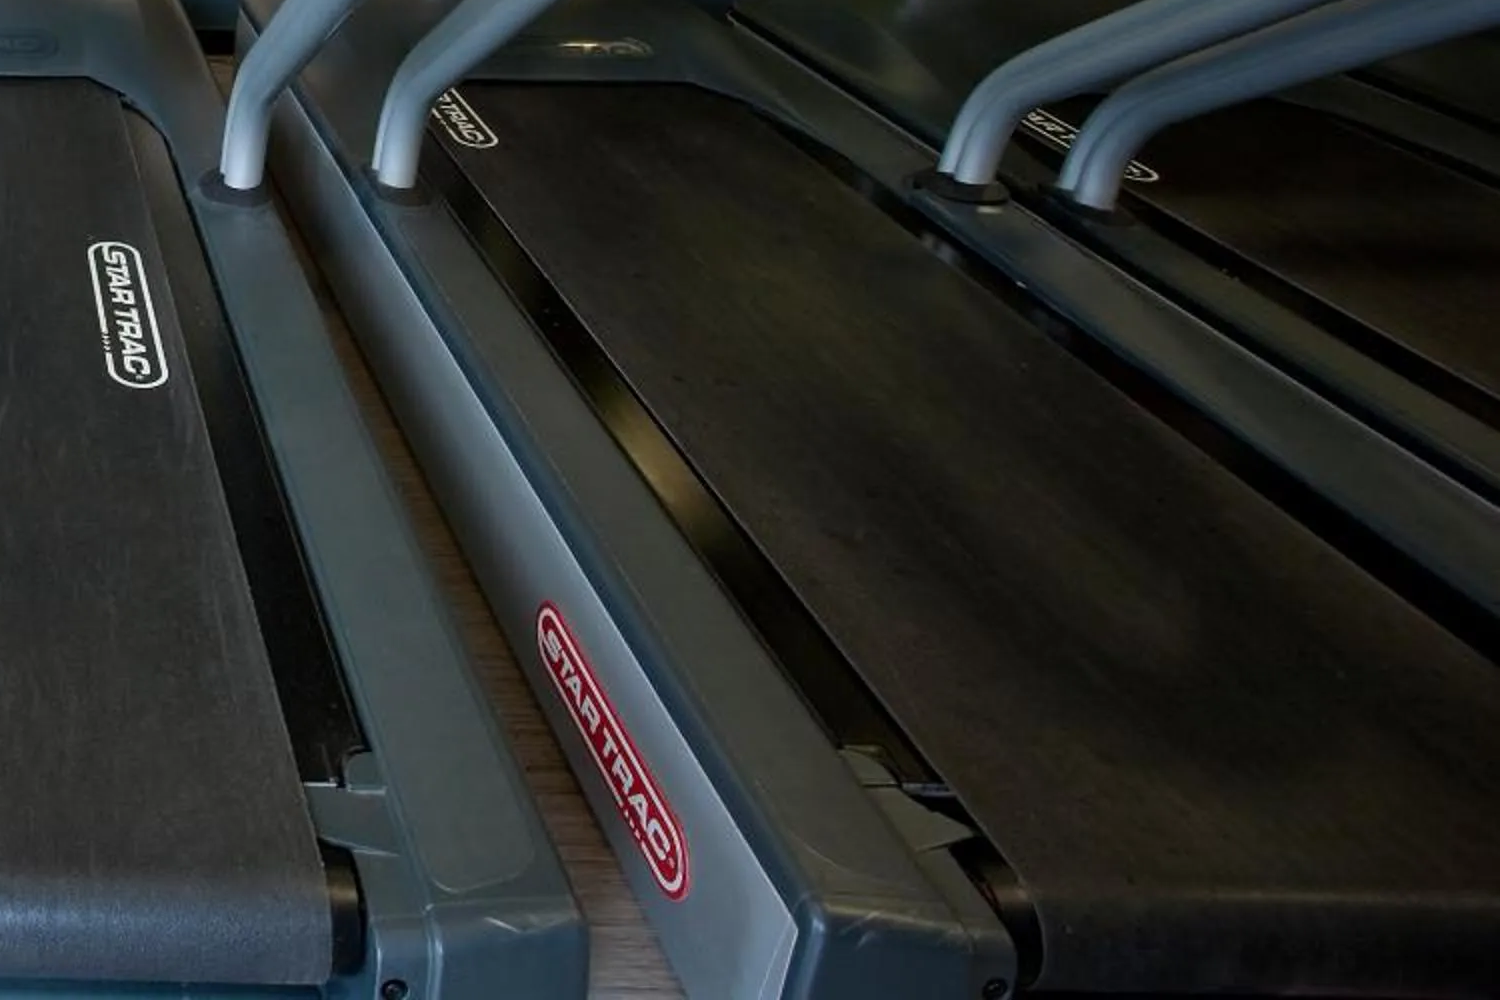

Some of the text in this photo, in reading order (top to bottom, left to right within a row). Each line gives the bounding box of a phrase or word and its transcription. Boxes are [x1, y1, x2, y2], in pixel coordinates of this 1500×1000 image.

[101, 247, 151, 375] STAR TRAC
[543, 628, 671, 861] STAR TRAC
